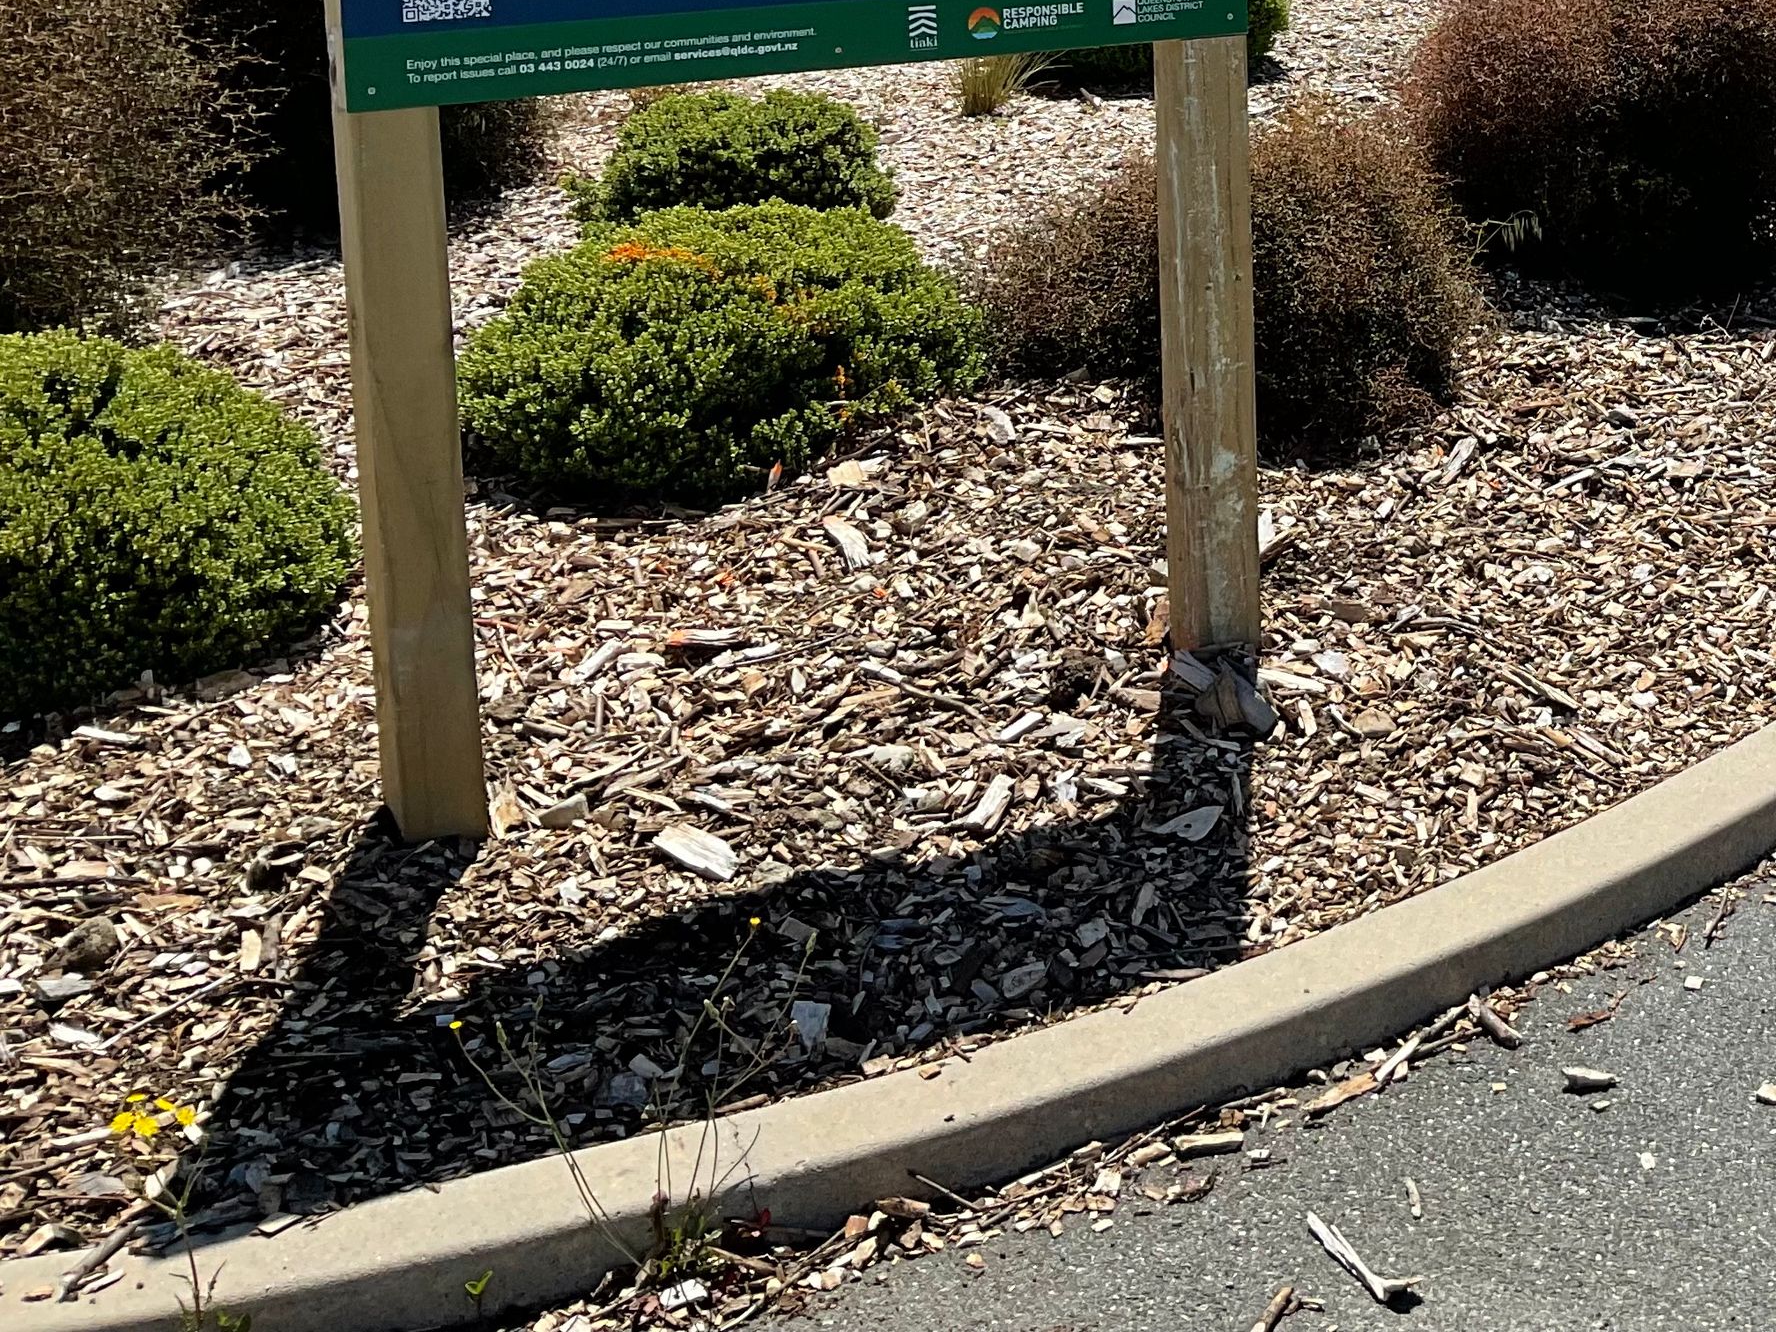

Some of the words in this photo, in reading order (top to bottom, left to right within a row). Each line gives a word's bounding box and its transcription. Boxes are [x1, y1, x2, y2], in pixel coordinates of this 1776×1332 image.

[1003, 2, 1084, 19] RESPONSIBLE
[1137, 2, 1165, 14] LAKES
[1165, 0, 1204, 12] DISTRICT
[1003, 15, 1058, 29] CAMPING
[1137, 13, 1176, 23] COUNCIL
[407, 73, 421, 84] To
[423, 70, 457, 83] report
[460, 69, 495, 79] issues
[497, 65, 517, 75] call
[519, 63, 535, 73] 03
[538, 61, 561, 71] 443
[564, 58, 594, 69] 0024
[597, 55, 627, 68] (24/7)
[629, 56, 642, 64] or
[644, 52, 671, 63] email
[674, 43, 798, 61] services@qldc.govt.nz
